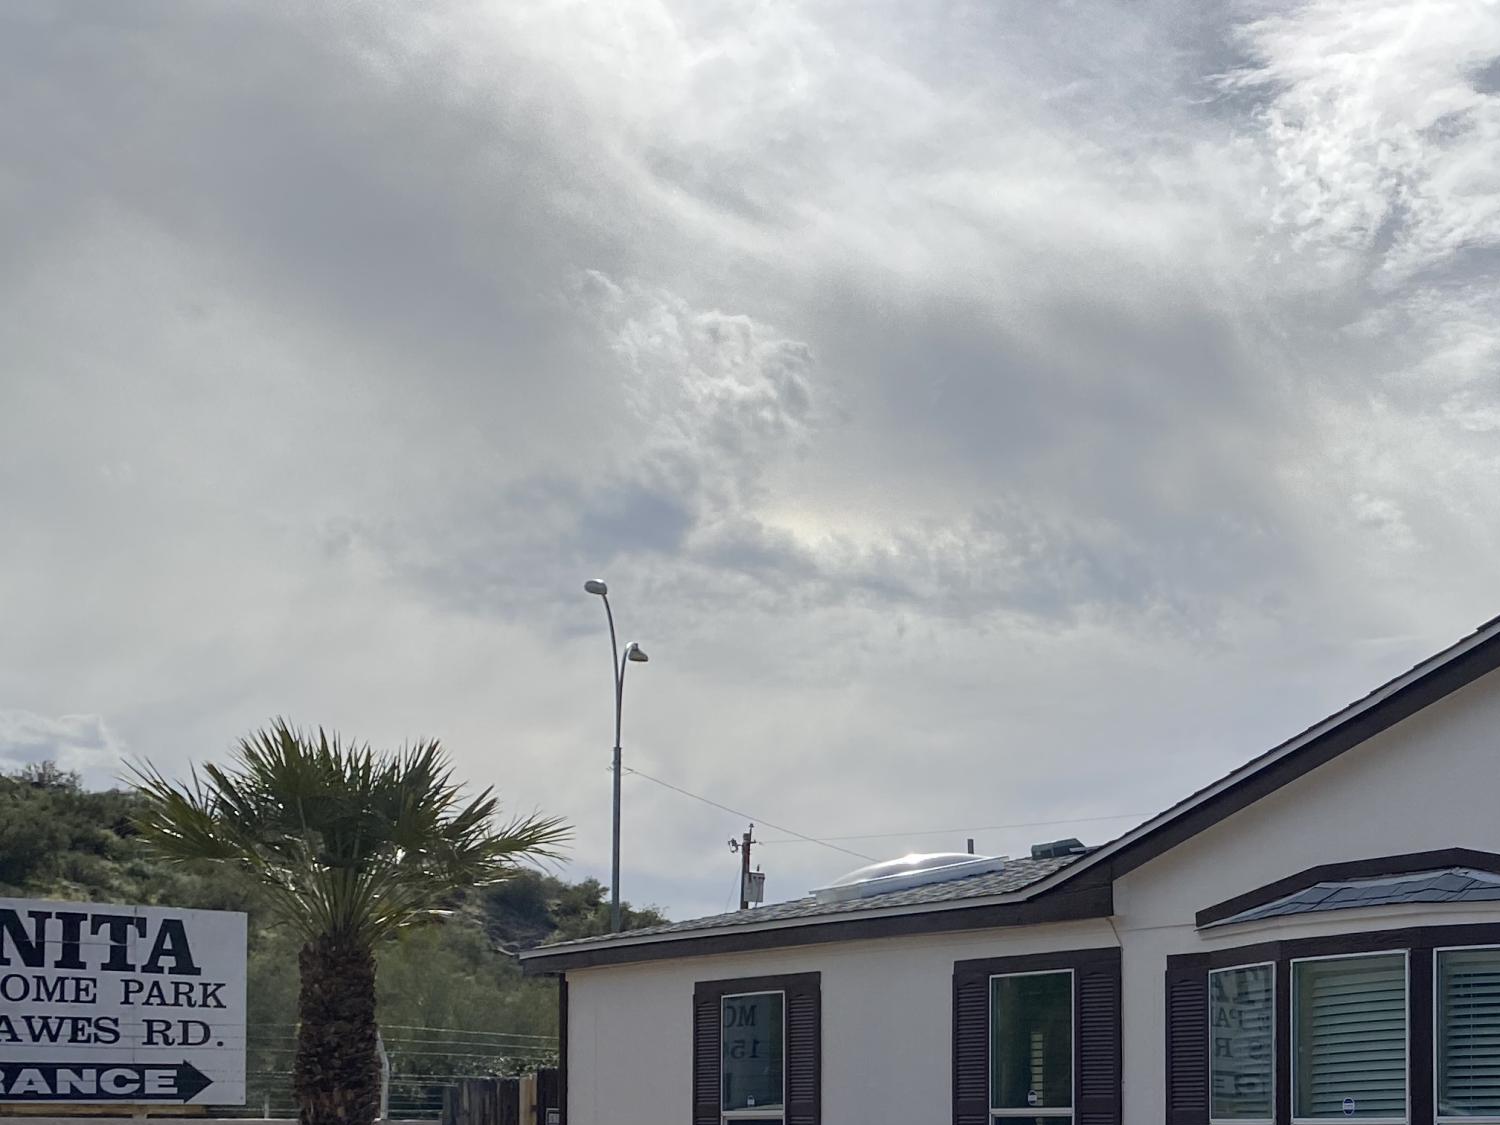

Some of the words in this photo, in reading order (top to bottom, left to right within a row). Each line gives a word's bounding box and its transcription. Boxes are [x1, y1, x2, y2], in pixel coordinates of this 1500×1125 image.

[0, 908, 201, 976] NITA
[1, 974, 97, 1004] OME
[120, 979, 227, 1008] PARK
[142, 1019, 224, 1047] RD.
